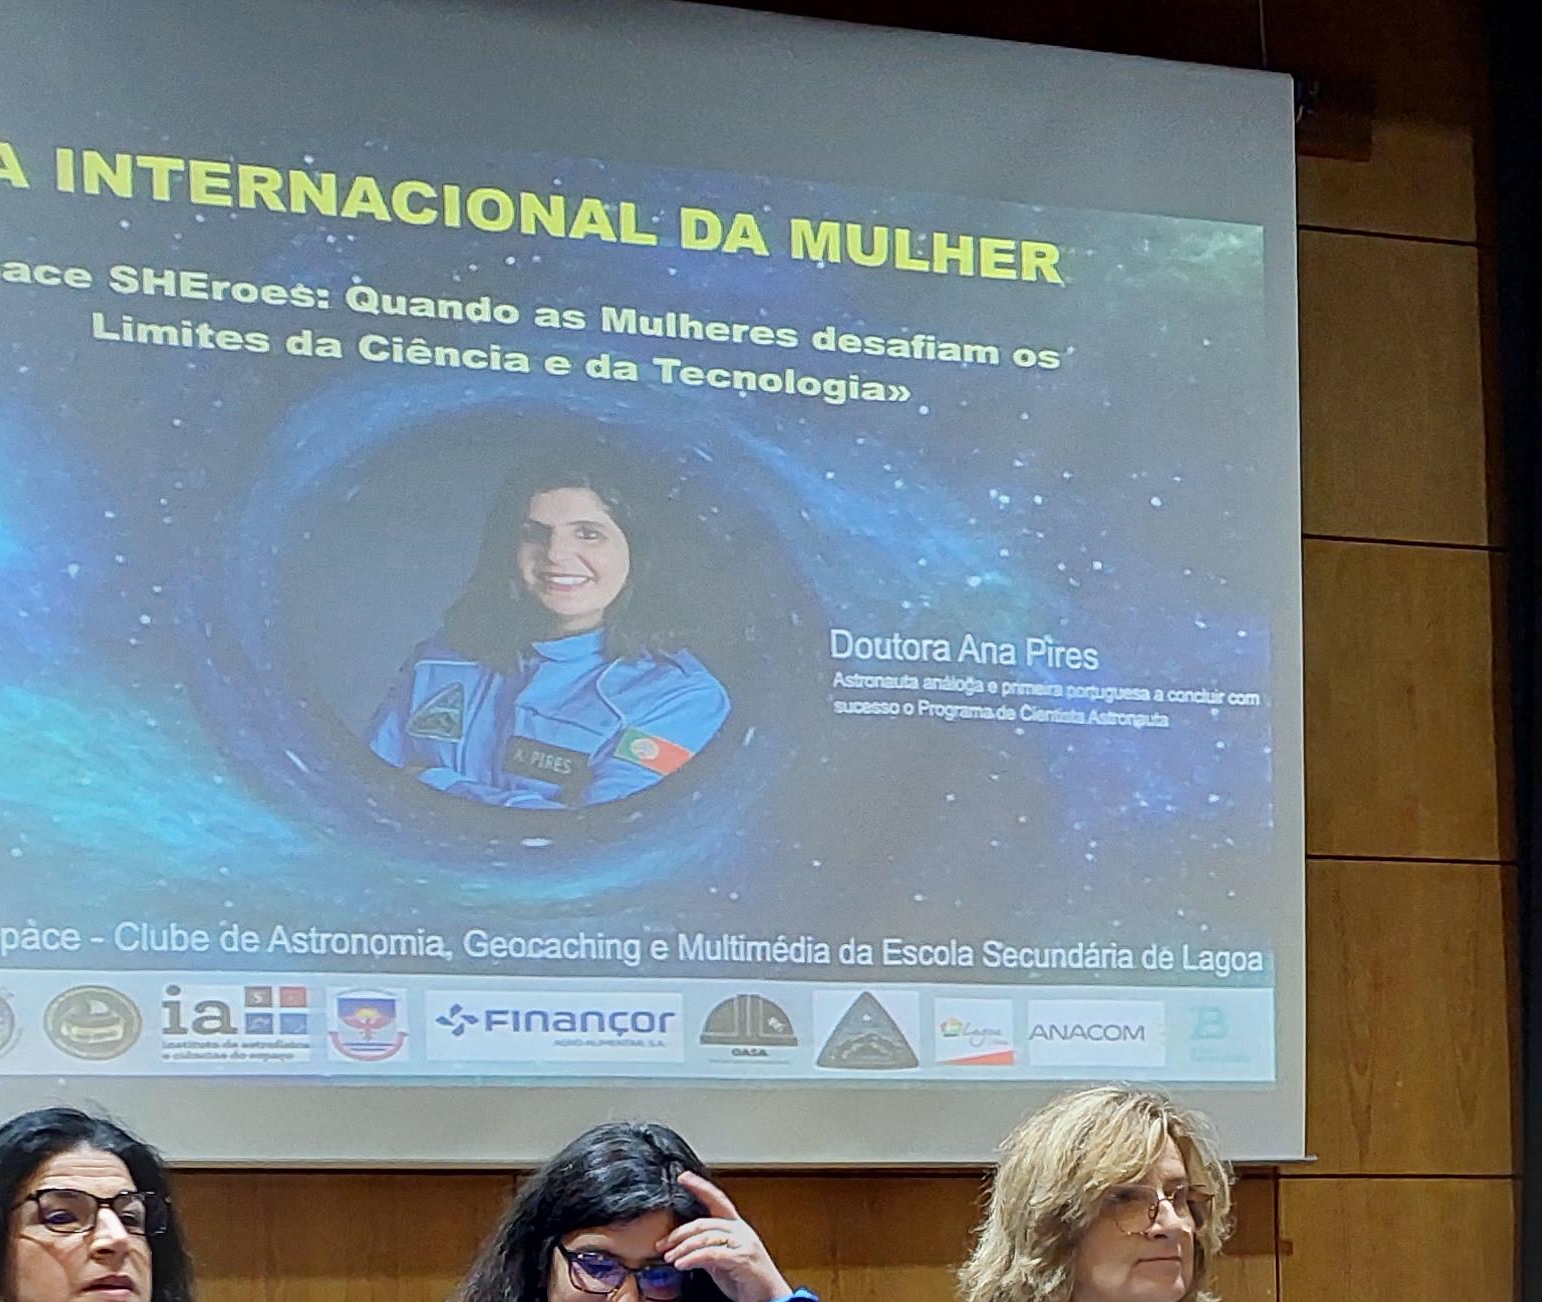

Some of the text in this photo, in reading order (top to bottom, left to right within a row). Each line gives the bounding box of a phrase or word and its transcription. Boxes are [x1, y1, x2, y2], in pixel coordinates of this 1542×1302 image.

[56, 148, 658, 246] INTERNACIONAL
[680, 207, 770, 256] DA
[790, 218, 1064, 284] MULHER
[109, 265, 331, 309] SHEroes:
[345, 284, 520, 325] Quando
[534, 306, 587, 330] as
[601, 306, 799, 348] Mulheres
[811, 326, 1000, 366] desafiam
[1012, 346, 1061, 369] os
[92, 312, 912, 405] Limites da Ciência e da Tecnologia»
[830, 628, 1100, 671] Doutora Ana Pires
[833, 672, 919, 690] Astronauta
[987, 681, 998, 694] e
[1002, 681, 1063, 698] primeira
[1066, 684, 1150, 703] portuguesa
[1167, 687, 1225, 705] concluir
[1228, 691, 1260, 706] com
[833, 699, 900, 716] sucesso
[903, 702, 915, 715] o
[917, 699, 993, 721] Programa
[1087, 709, 1170, 729] Astronauta
[114, 921, 210, 952] Clube
[219, 923, 261, 953] de
[267, 925, 454, 960] Astronomia,
[463, 928, 641, 967] Geocaching
[650, 938, 670, 961] e
[678, 932, 831, 965] Multimédia
[839, 936, 874, 966] da
[882, 938, 974, 967] Escola
[982, 940, 1135, 971] Secundária
[1141, 944, 1175, 971] de
[1183, 945, 1265, 978] Lagoa
[161, 984, 238, 1036] ia
[1028, 1023, 1146, 1042] ANACOM
